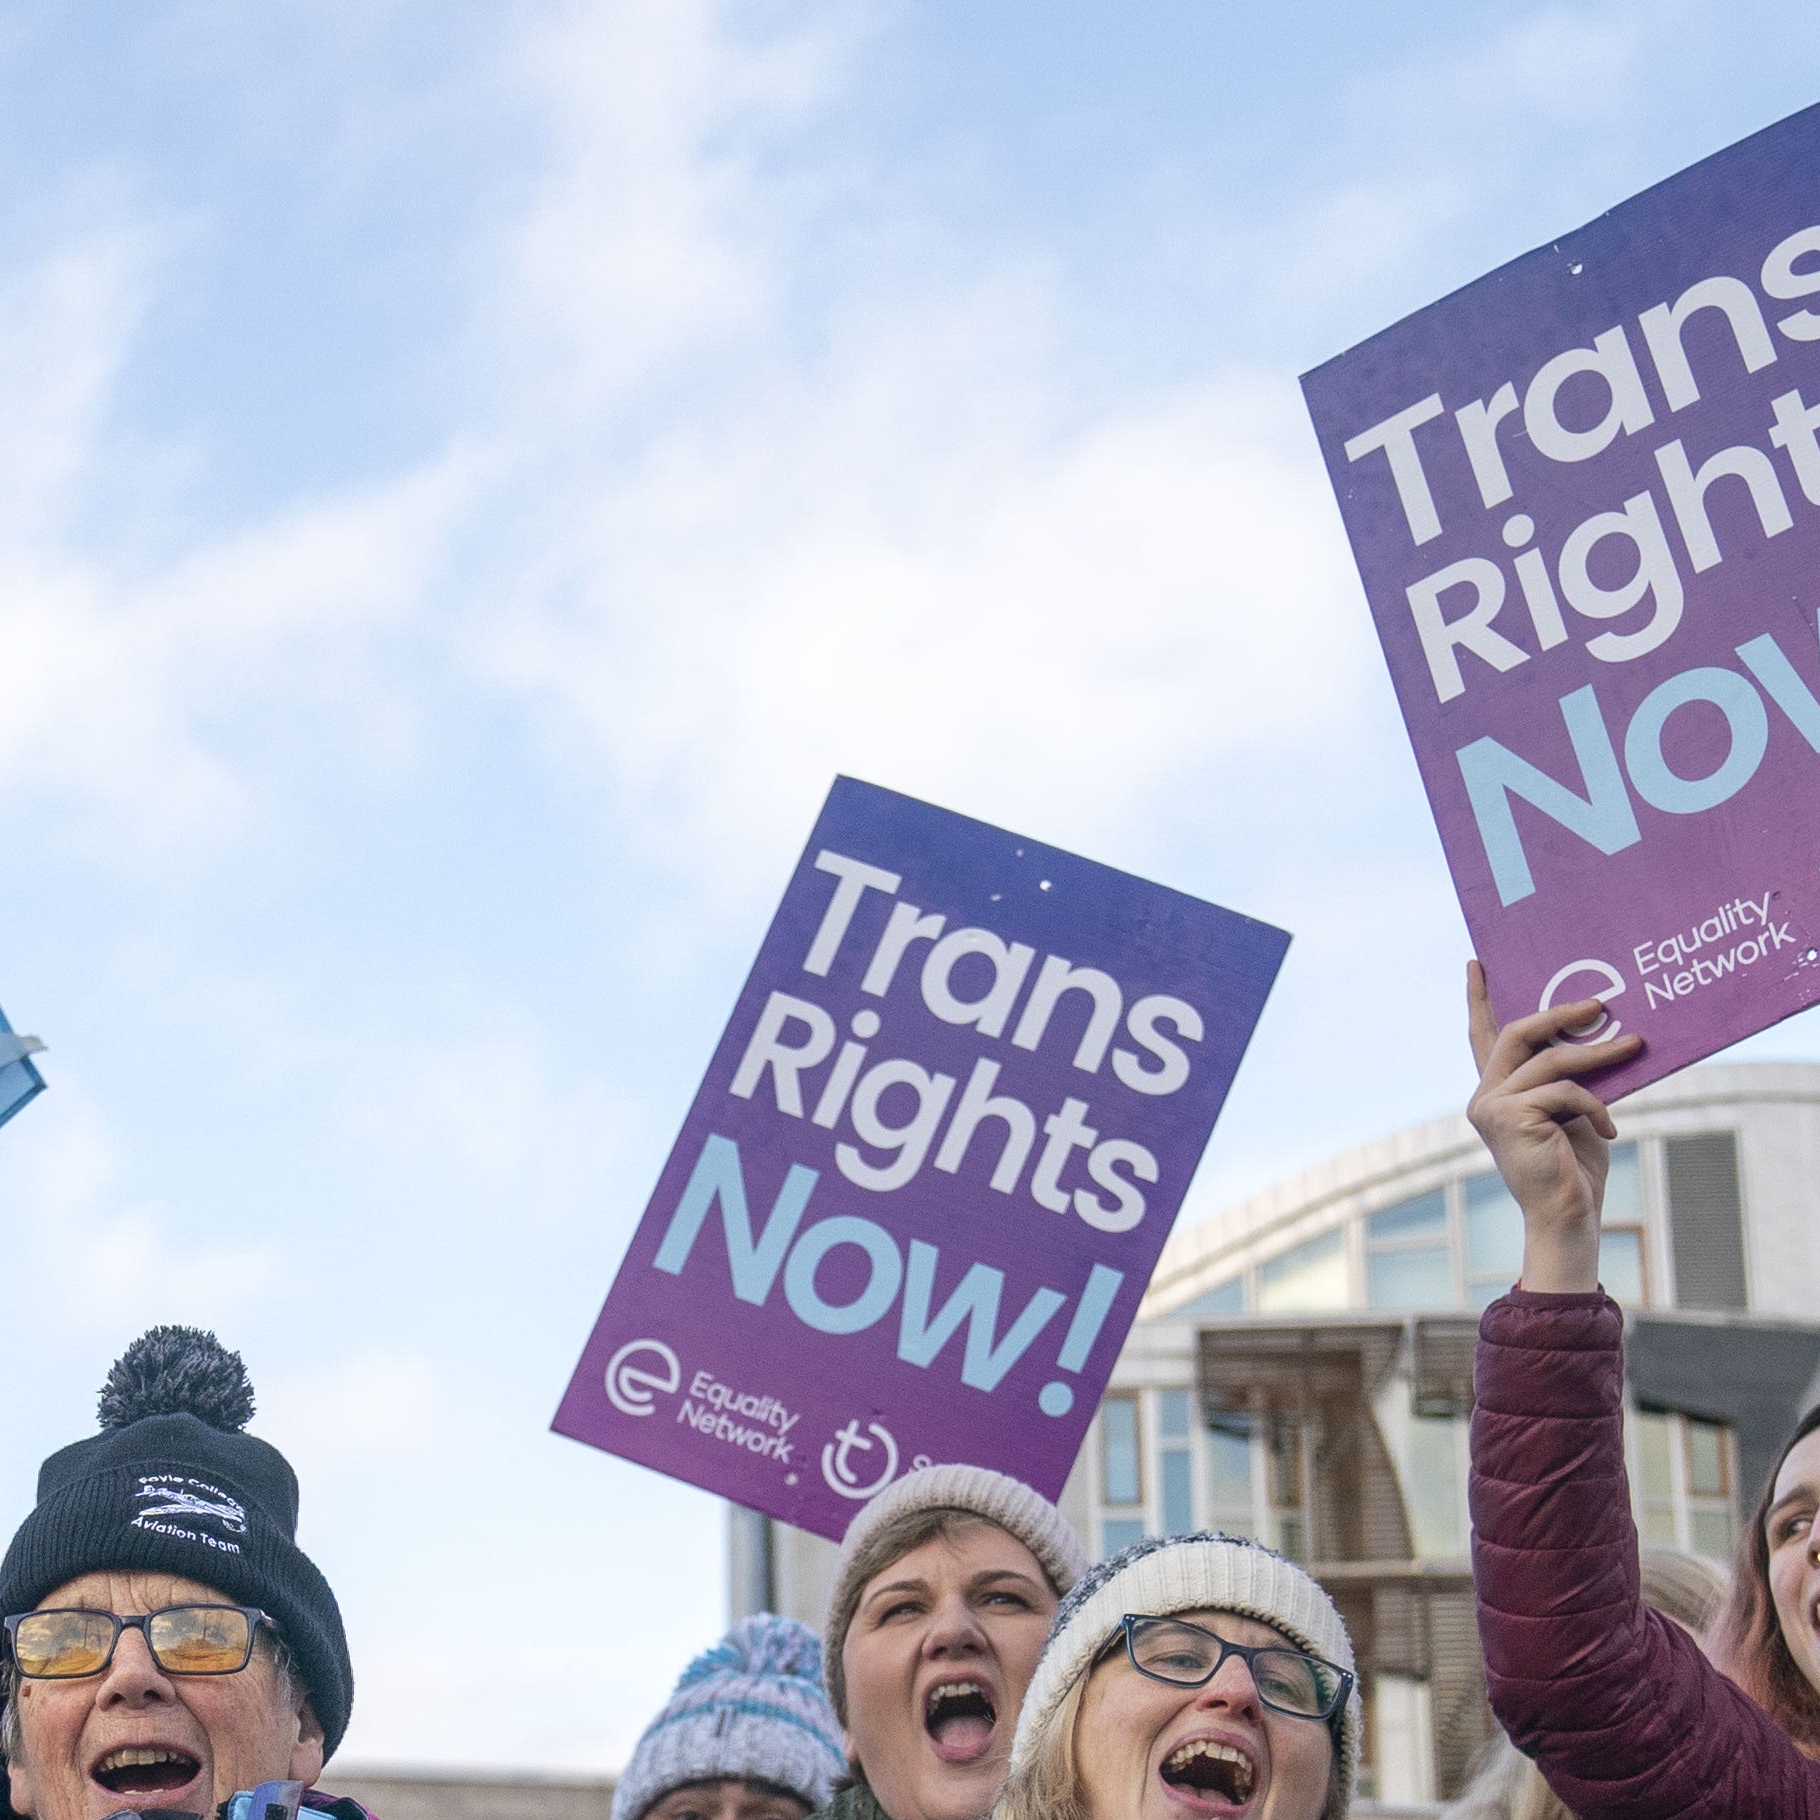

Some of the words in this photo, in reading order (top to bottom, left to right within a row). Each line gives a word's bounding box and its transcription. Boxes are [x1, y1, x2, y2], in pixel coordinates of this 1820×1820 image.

[796, 850, 1204, 1097] Trans
[1633, 891, 1770, 975] Equality
[1644, 921, 1796, 1010] Network
[728, 991, 1159, 1233] Rights
[654, 1132, 1124, 1418] Now!
[677, 1404, 793, 1465] Network
[689, 1371, 801, 1432] Equality
[131, 1516, 196, 1541] Aviation
[200, 1533, 240, 1554] Team
